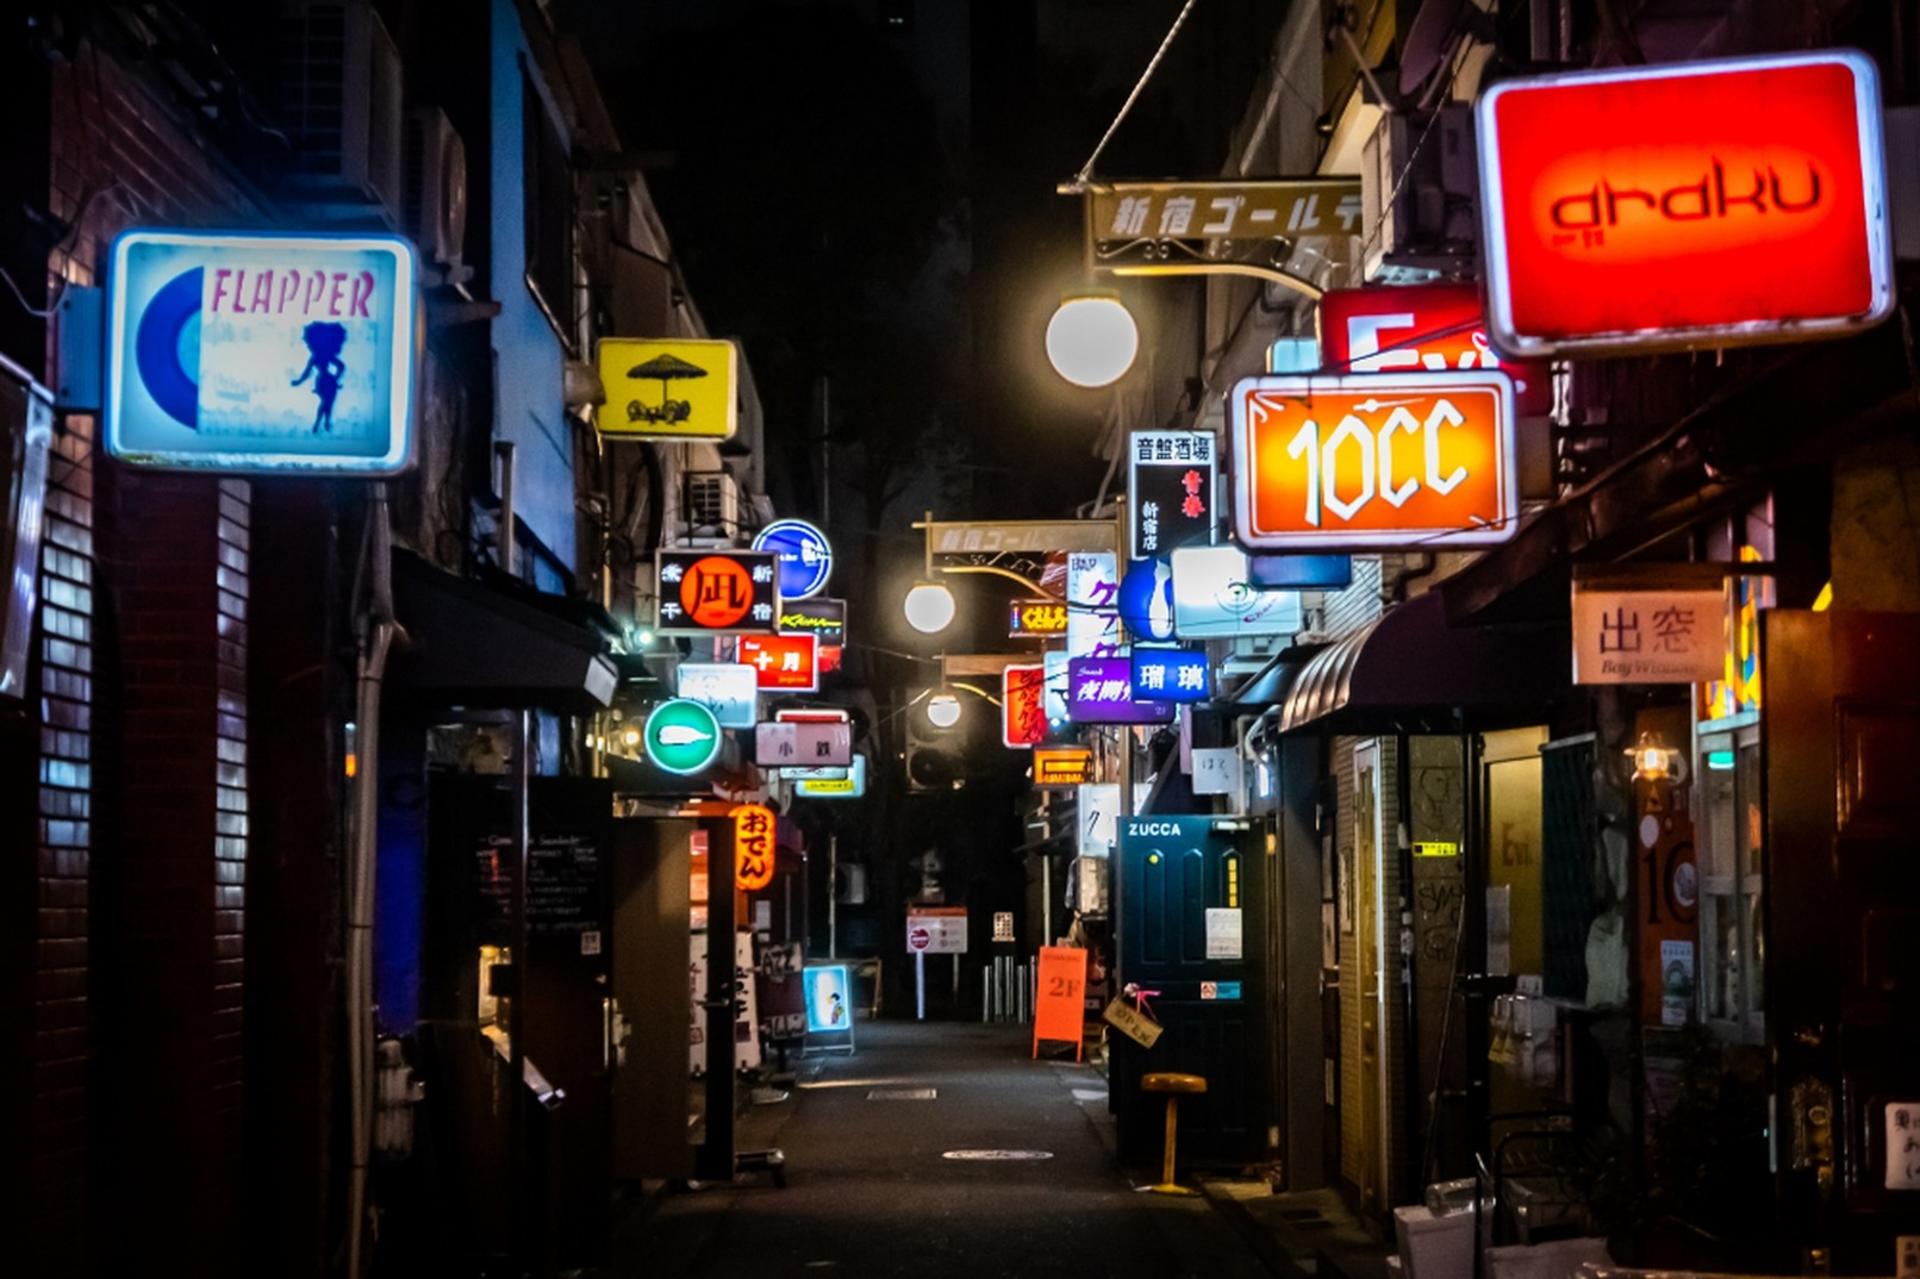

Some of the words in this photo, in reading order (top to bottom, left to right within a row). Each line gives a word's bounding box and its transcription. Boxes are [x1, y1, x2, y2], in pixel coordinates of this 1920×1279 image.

[211, 266, 375, 318] FLAPPER
[1137, 437, 1210, 460] 音盤酒場
[1141, 500, 1159, 551] 新宿店
[753, 651, 800, 672] 十月
[1139, 664, 1204, 690] 瑠璃
[1128, 823, 1182, 836] ZUCCA
[740, 812, 768, 878] おでん
[1048, 976, 1082, 998] 2F
